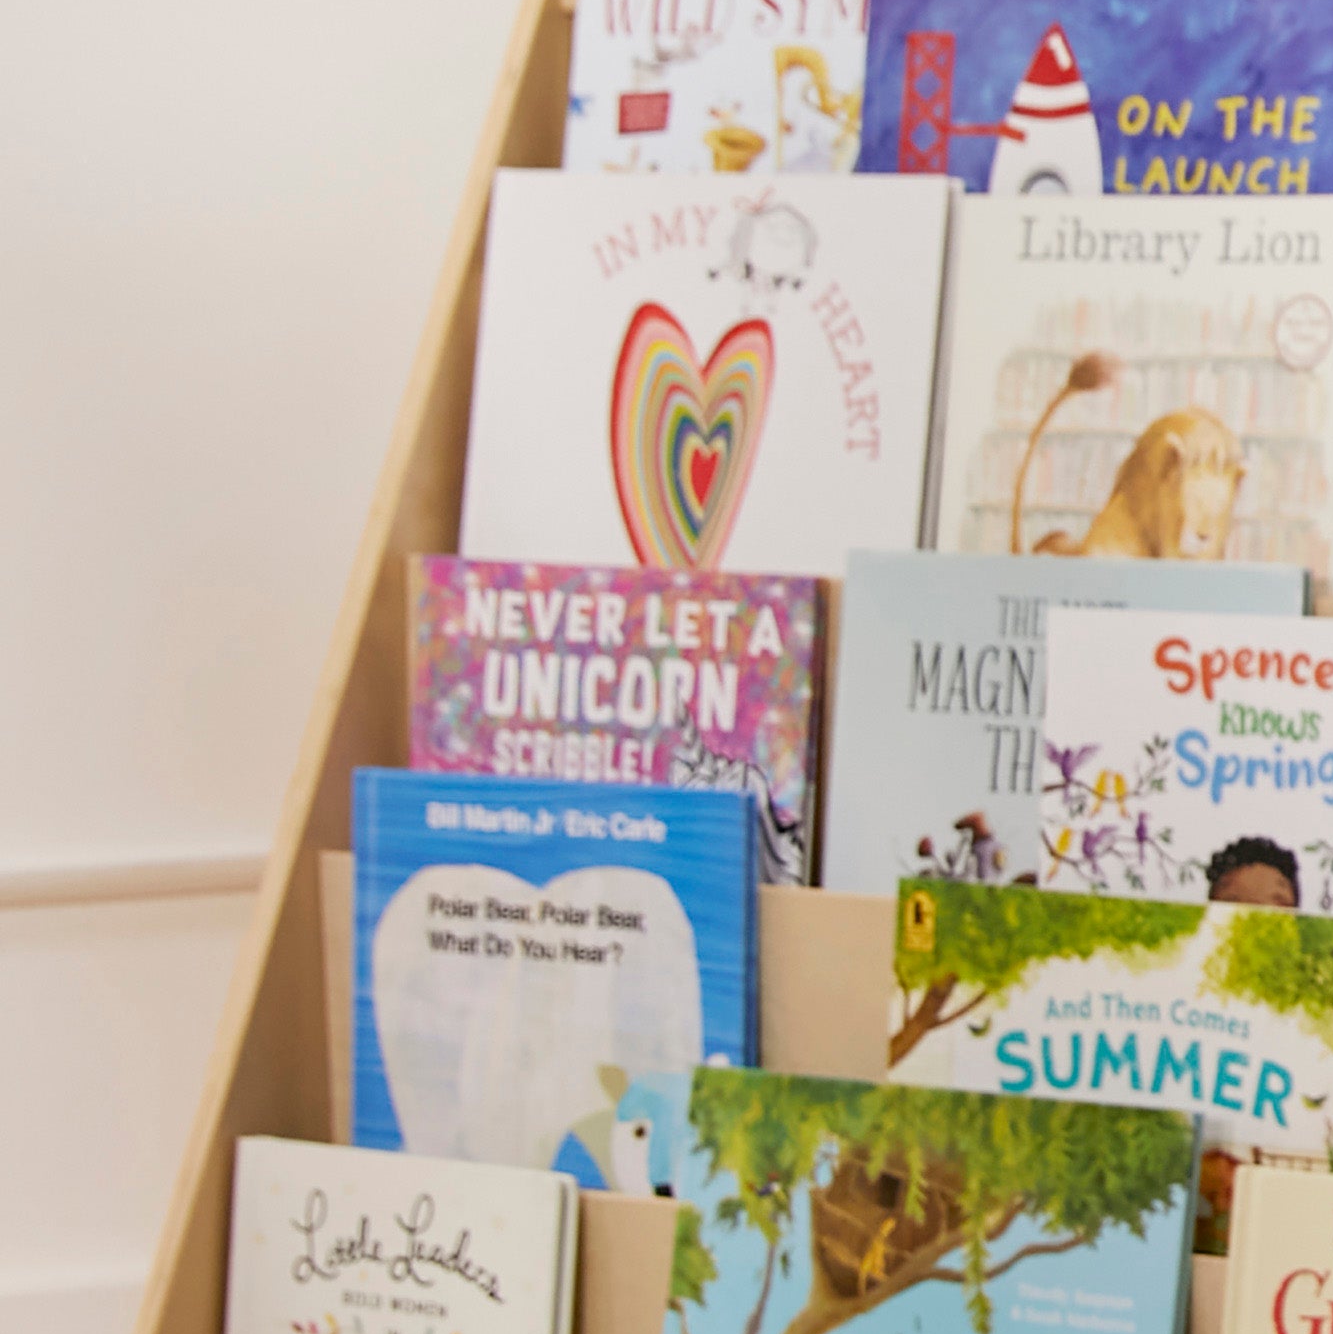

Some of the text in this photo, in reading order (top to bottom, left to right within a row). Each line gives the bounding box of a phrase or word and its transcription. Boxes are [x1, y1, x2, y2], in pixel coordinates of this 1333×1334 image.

[1116, 94, 1322, 144] ON THE
[1113, 155, 1311, 195] LAUNCH
[1017, 215, 1322, 276] Library Lion
[593, 203, 881, 461] IN MY HEART
[463, 586, 784, 658] NEVER LET A
[482, 647, 740, 734] UNICORN
[425, 801, 461, 831] Bill
[463, 803, 532, 835] Martin
[428, 892, 477, 919] Polar
[539, 899, 590, 928] Polar
[428, 929, 625, 967] What Do You Hear?
[1046, 992, 1251, 1039] And Then Comes
[995, 1028, 1294, 1129] SUMMER
[290, 1187, 506, 1305] Little Leaders
